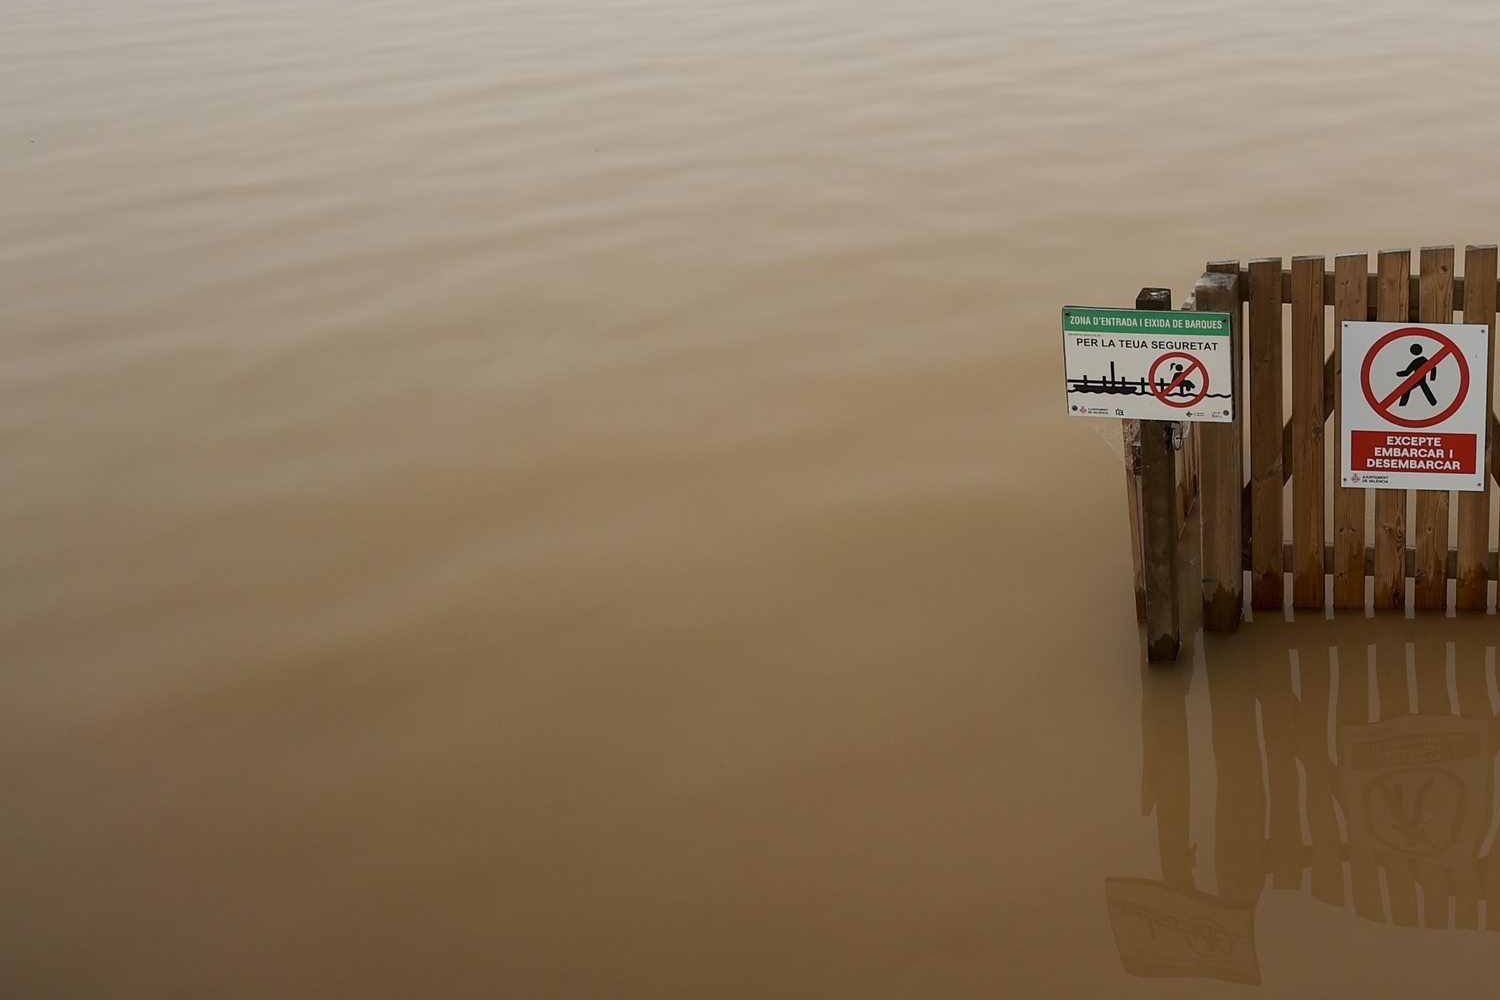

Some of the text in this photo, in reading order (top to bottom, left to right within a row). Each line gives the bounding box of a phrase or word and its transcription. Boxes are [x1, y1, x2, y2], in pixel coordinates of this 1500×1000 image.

[1070, 316, 1091, 325] ZONA
[1093, 316, 1138, 327] D'ENTRADA
[1144, 318, 1171, 328] EIXIDA
[1173, 319, 1183, 328] DE
[1185, 319, 1222, 330] BARQUES
[1076, 338, 1218, 351] PER LA TEUA SEGURETAT
[1386, 436, 1442, 447] EXCEPTE
[1374, 447, 1453, 459] EMBARCAR I
[1366, 458, 1461, 470] DESEMBARCAR
